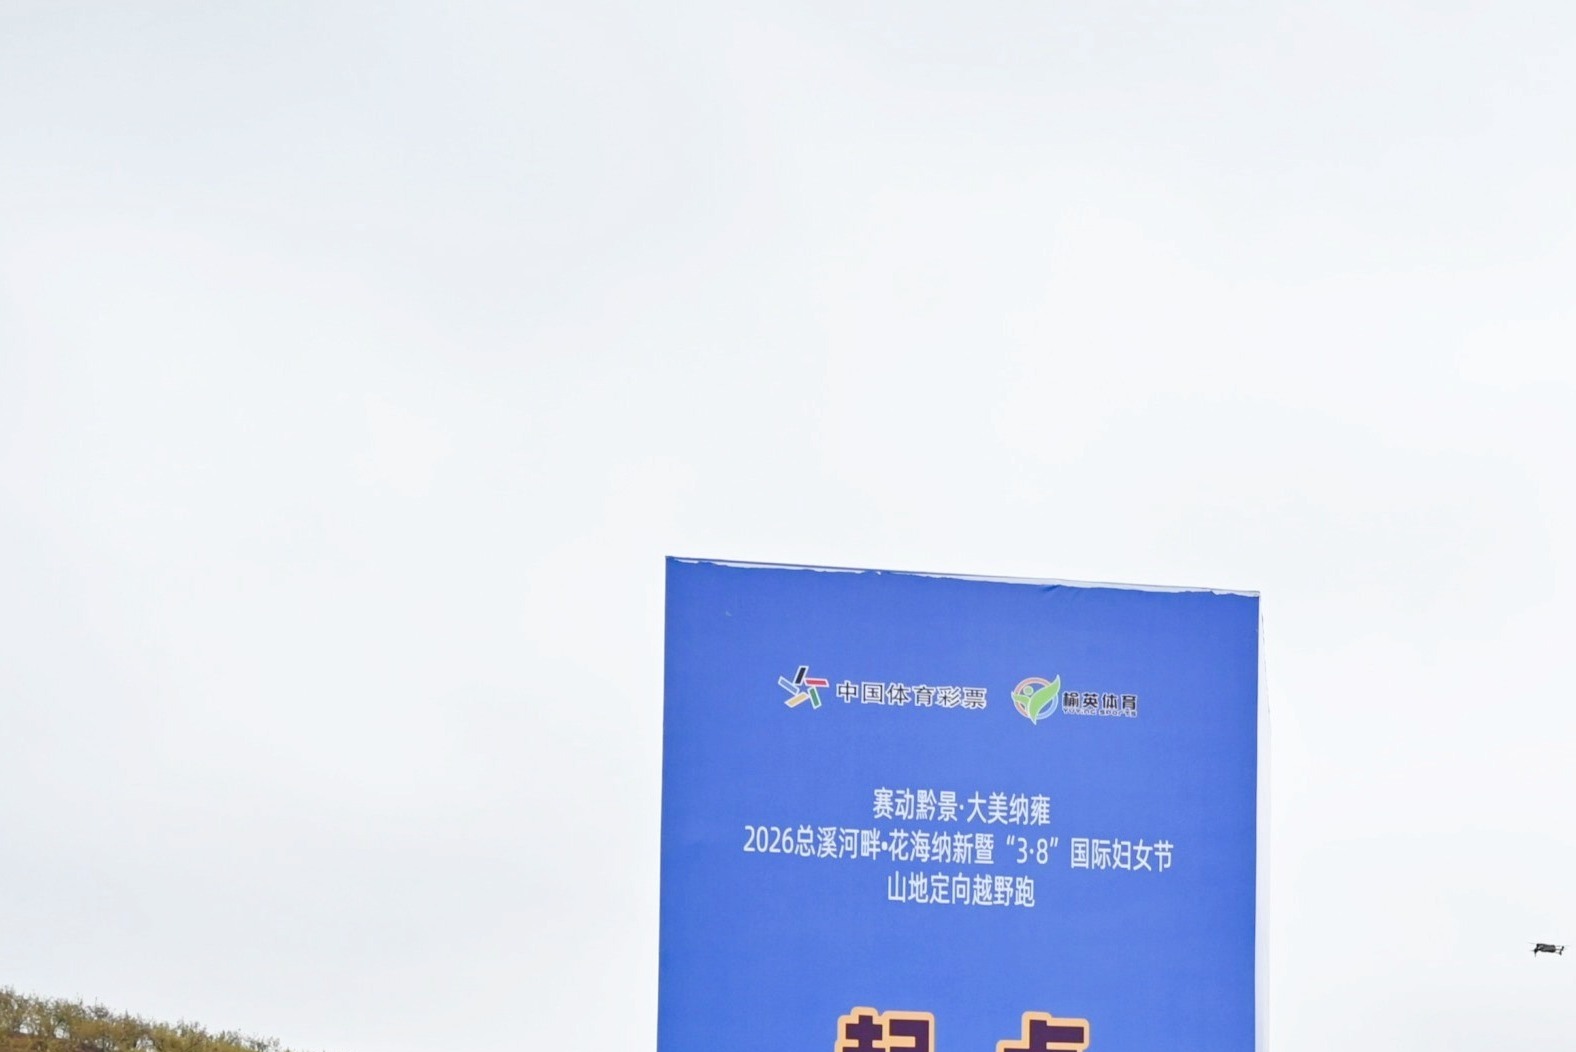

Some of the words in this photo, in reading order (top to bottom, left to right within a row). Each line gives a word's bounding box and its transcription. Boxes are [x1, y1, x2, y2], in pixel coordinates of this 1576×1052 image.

[836, 680, 987, 710] 中国体育彩票
[873, 786, 1050, 826] 赛动黔景·大美纳雍
[887, 870, 1036, 908] 山地定向越野跑
